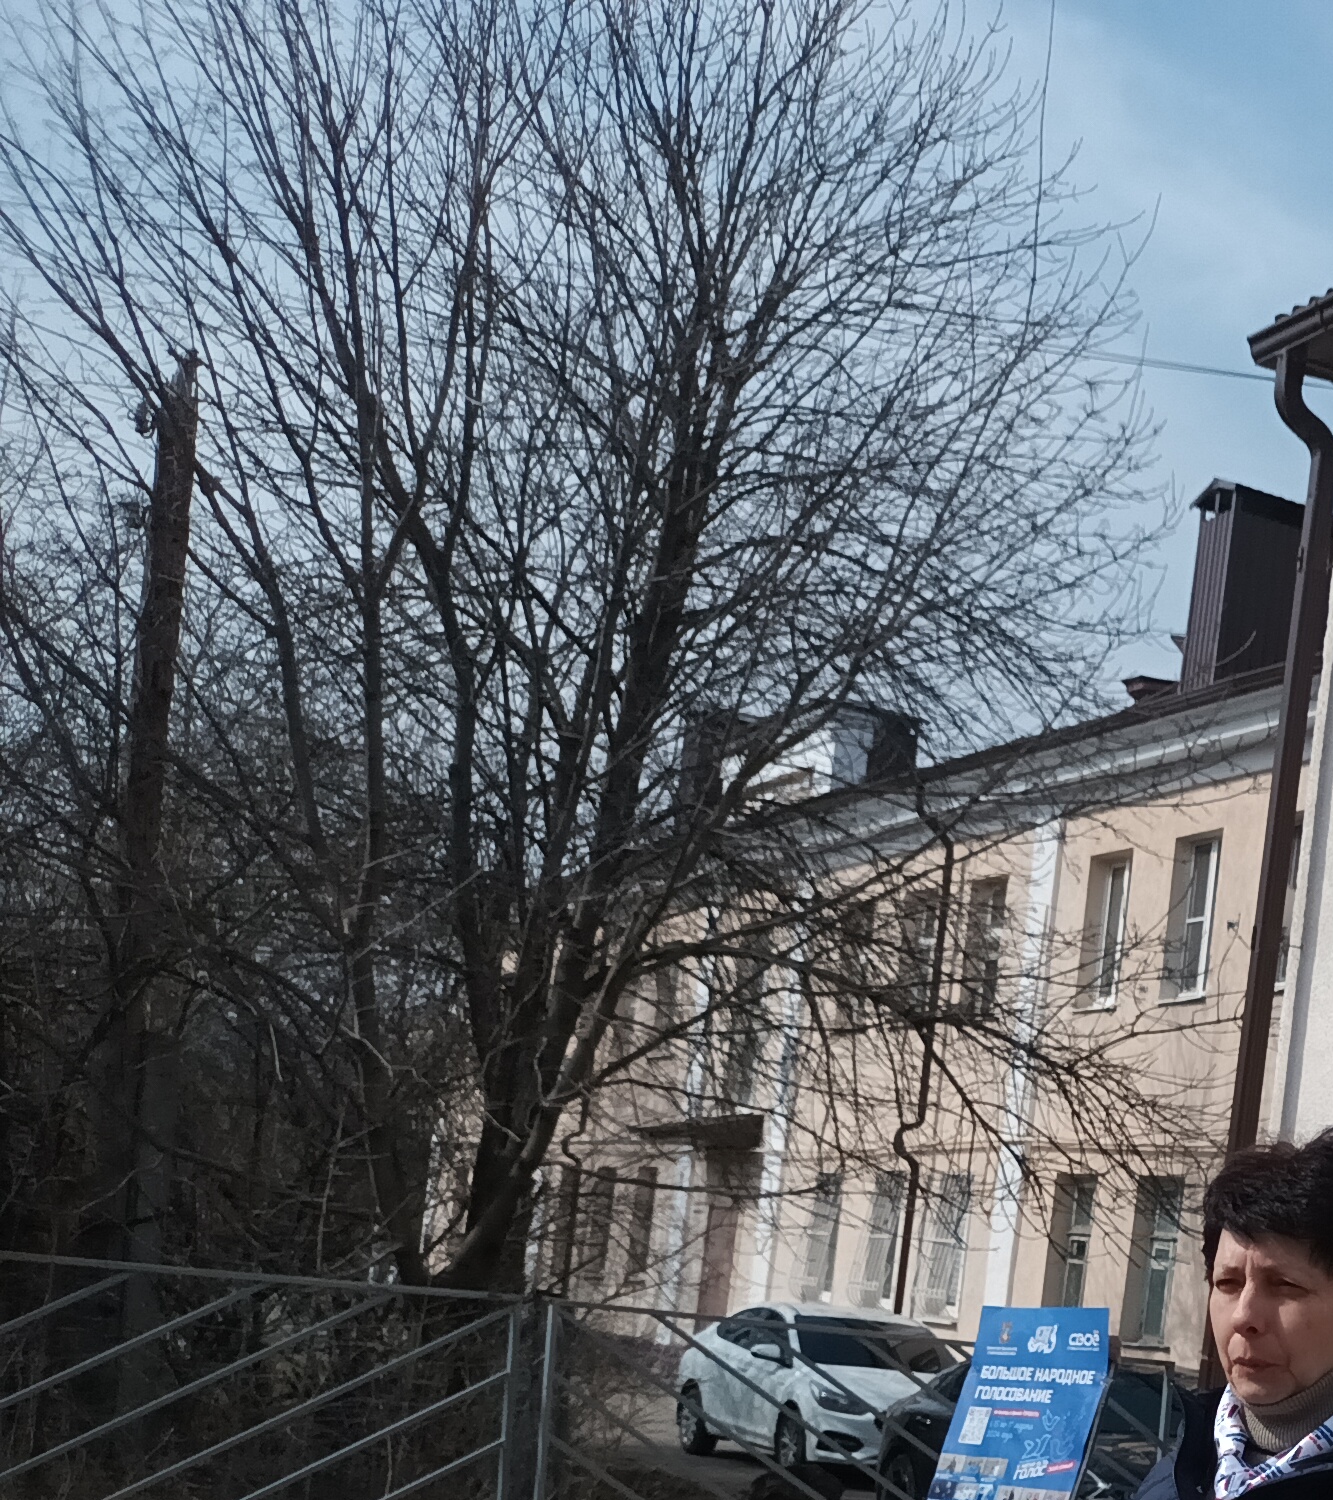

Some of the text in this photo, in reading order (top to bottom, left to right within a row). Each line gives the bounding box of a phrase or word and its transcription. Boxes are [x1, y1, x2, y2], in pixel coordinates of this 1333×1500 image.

[980, 1365, 1096, 1385] БОЛЬШОЕ НАРОДНОЕ
[974, 1385, 1054, 1403] ГОЛОСОВАНИЕ
